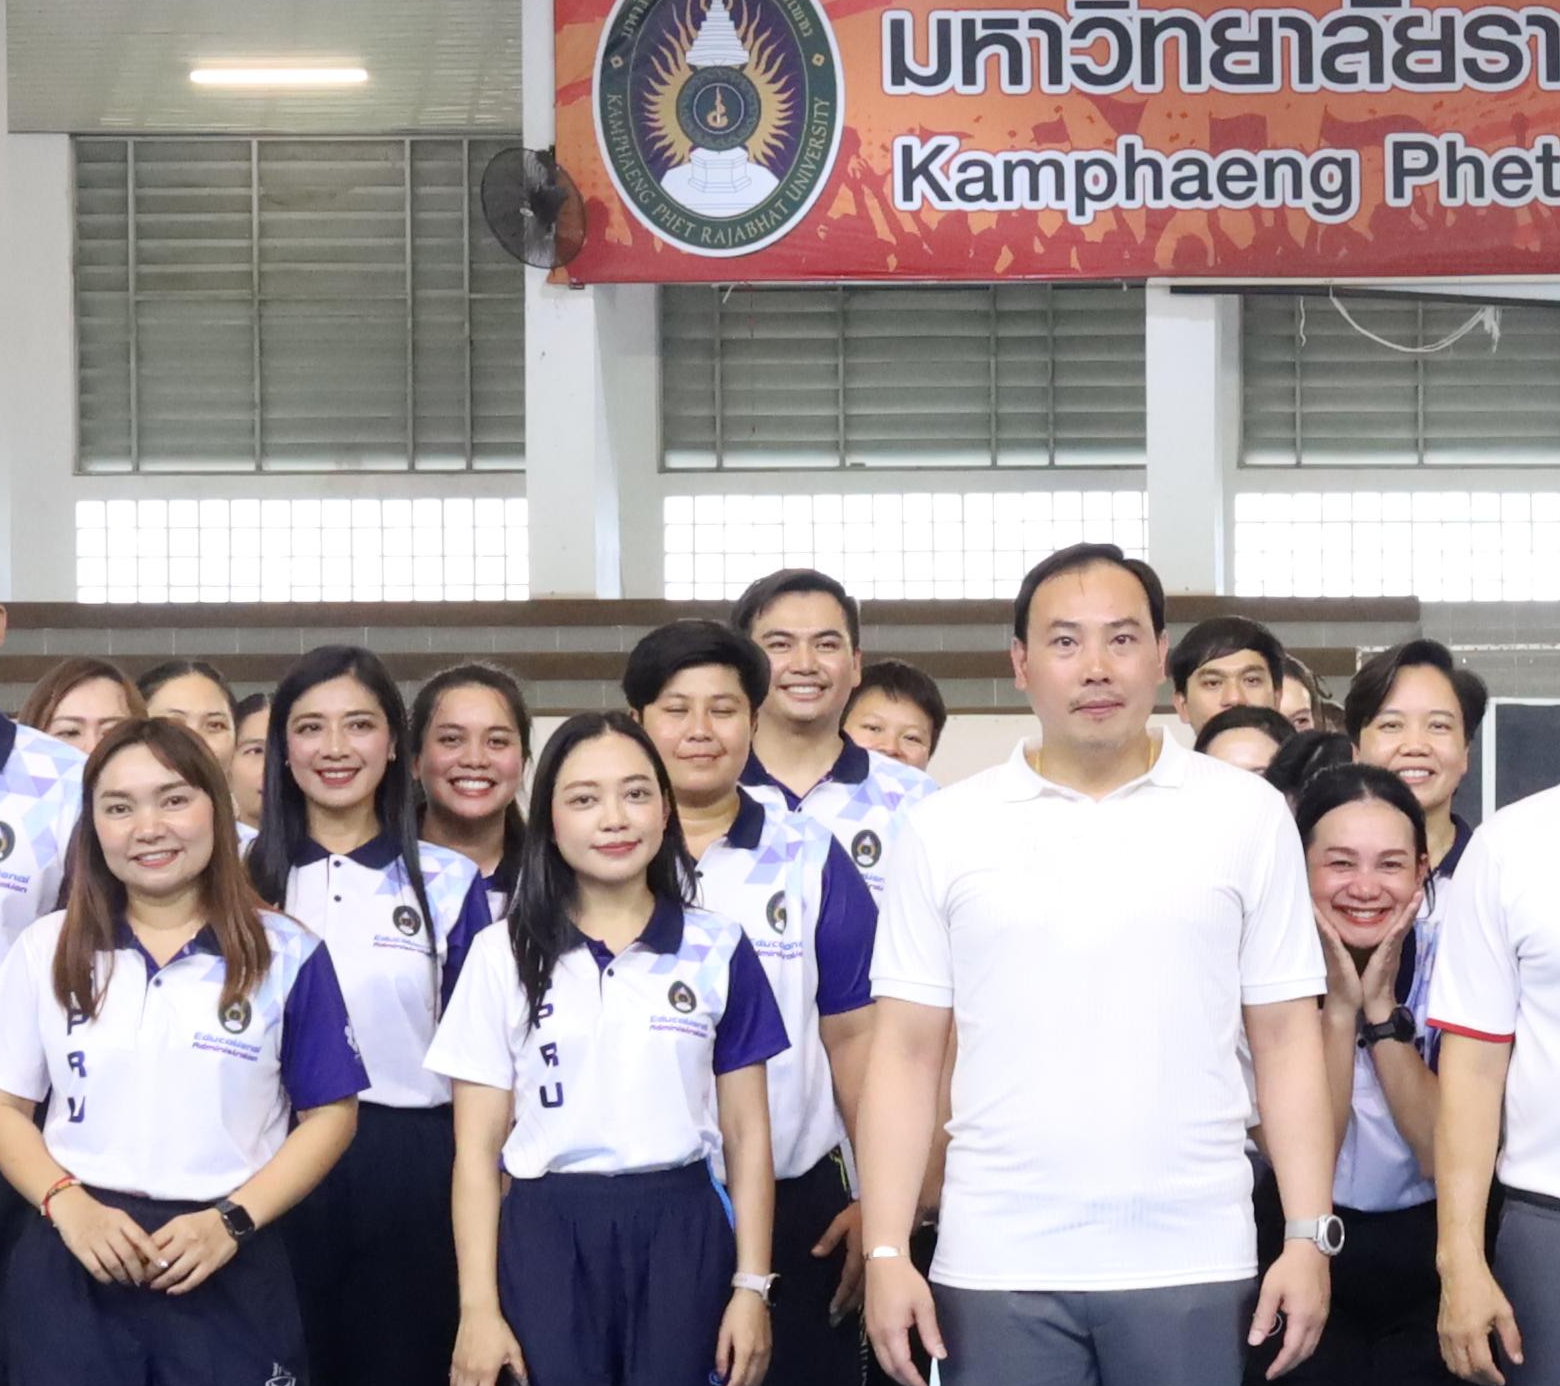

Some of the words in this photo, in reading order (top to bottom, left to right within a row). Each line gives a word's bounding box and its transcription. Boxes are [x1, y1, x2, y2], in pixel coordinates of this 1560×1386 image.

[606, 93, 656, 204] KAMPHAENG
[652, 204, 696, 238] PHET
[700, 199, 791, 248] RAJABHAT
[785, 97, 831, 201] UNIVERSITY
[900, 141, 1354, 216] Kamphaeng
